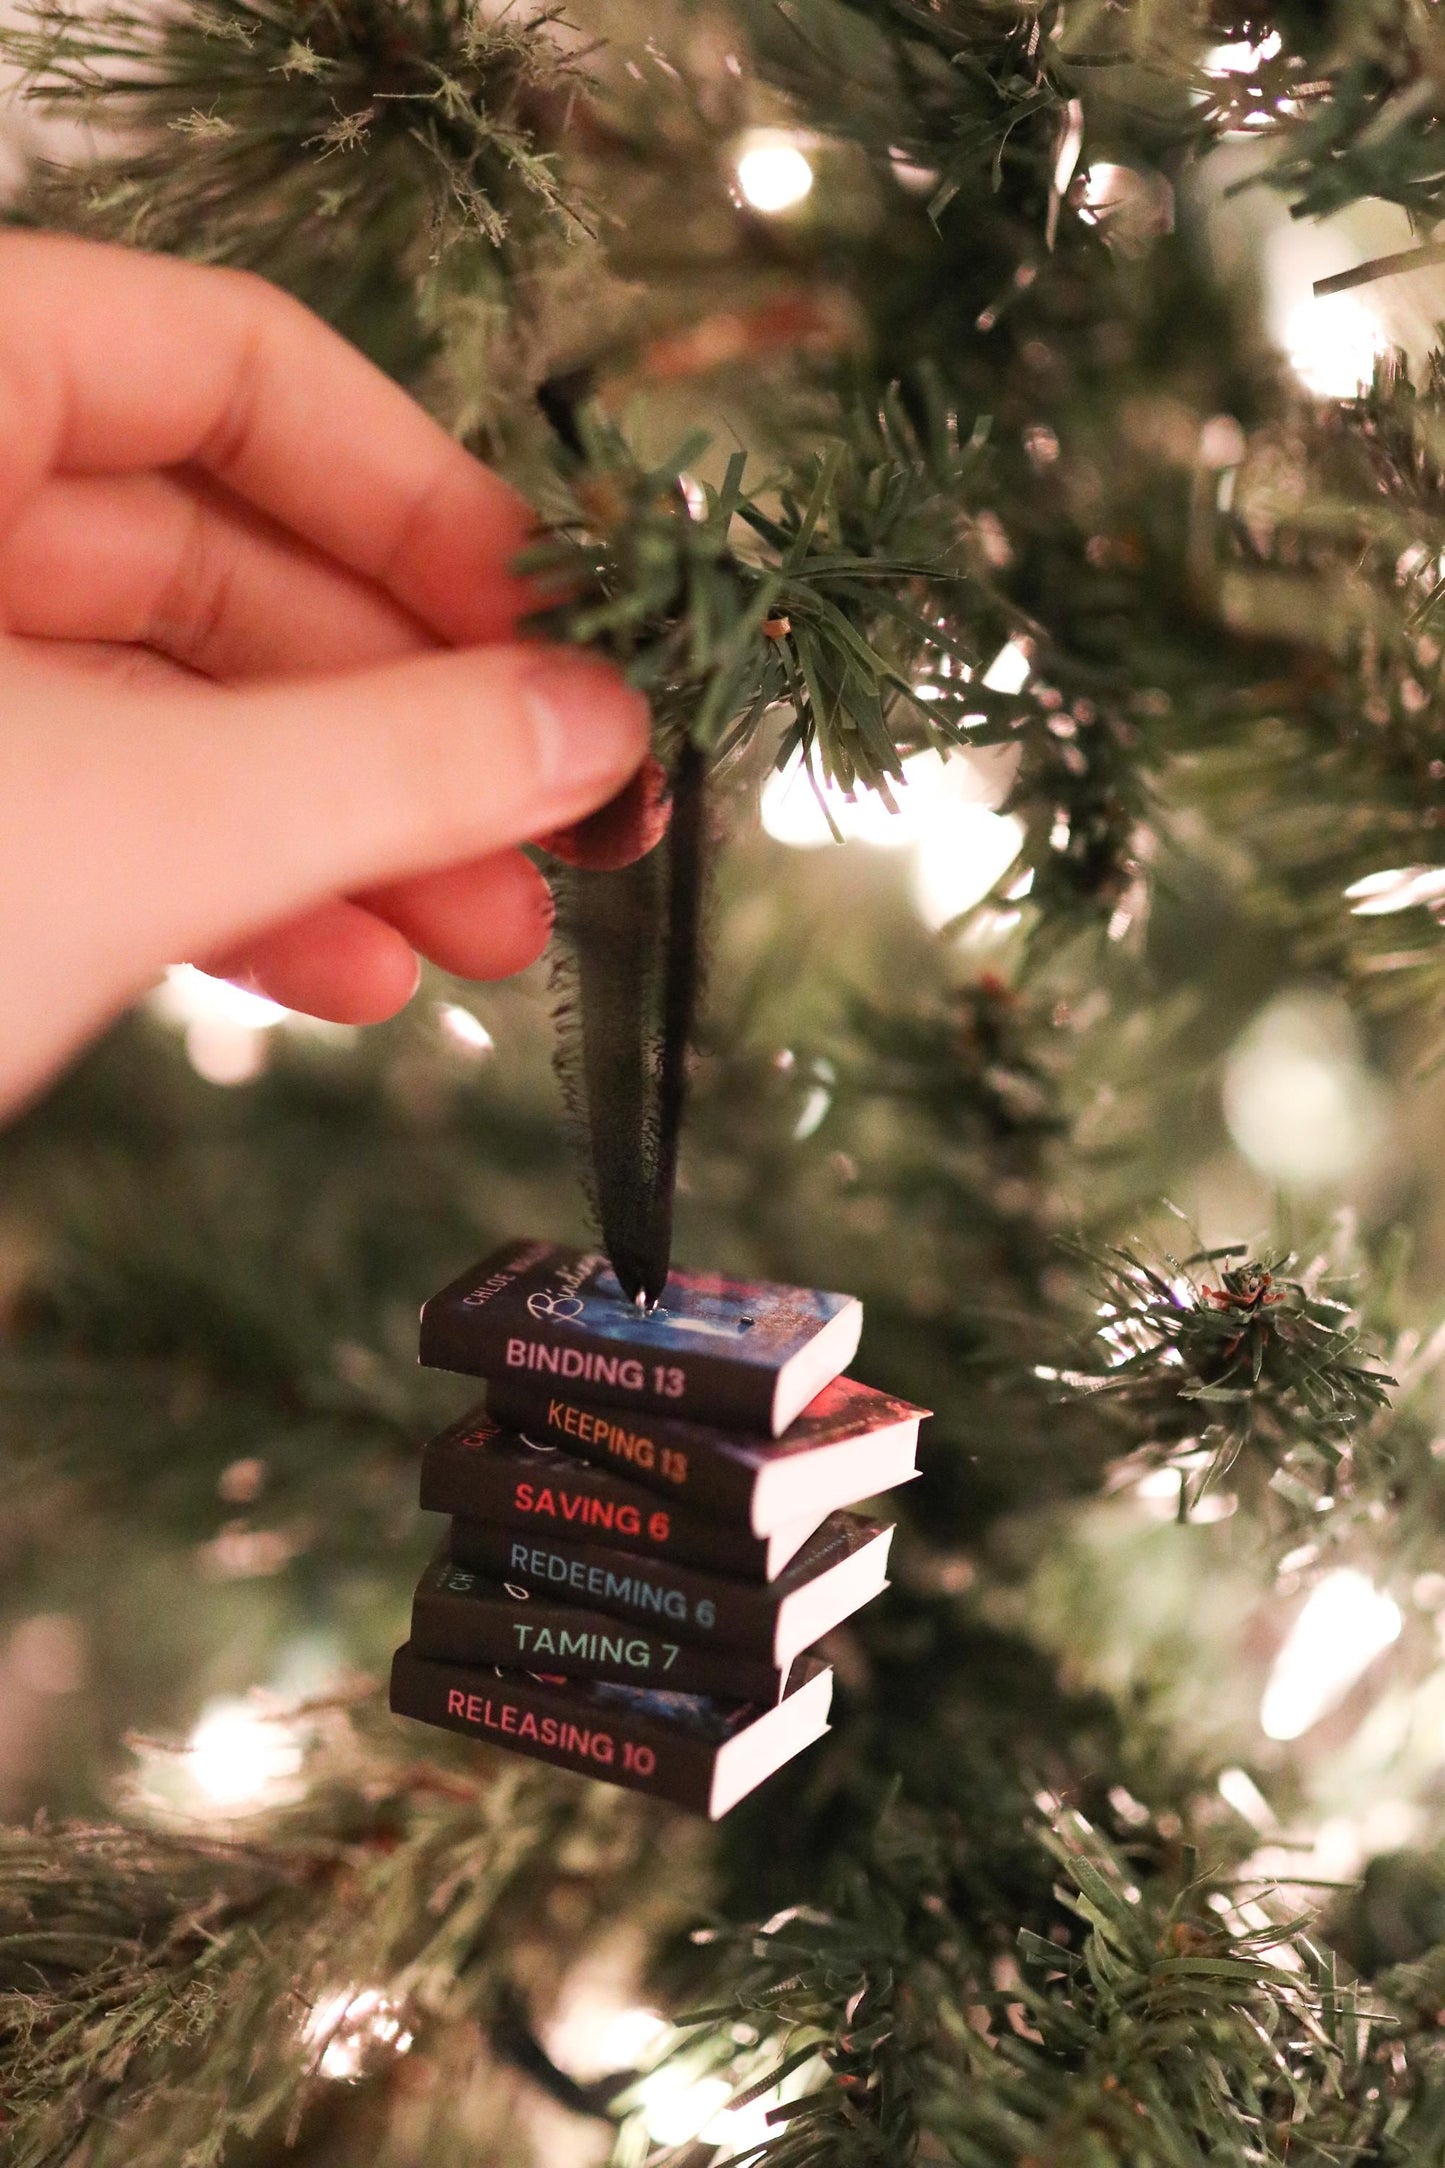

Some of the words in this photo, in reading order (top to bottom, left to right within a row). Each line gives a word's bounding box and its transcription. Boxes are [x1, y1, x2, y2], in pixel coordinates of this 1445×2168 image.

[462, 1272, 517, 1306] CHLOE
[505, 1338, 644, 1391] BINDING
[652, 1364, 686, 1399] 13
[547, 1398, 655, 1470] KEEPING
[661, 1447, 688, 1485] 13
[514, 1483, 641, 1536] SAVING
[648, 1511, 670, 1542] 6
[510, 1543, 687, 1621] REDEEMING
[694, 1598, 716, 1629] 6
[513, 1623, 651, 1668] TAMING
[661, 1644, 681, 1670] 7
[447, 1688, 616, 1766] RELEASING
[622, 1742, 657, 1777] 10
